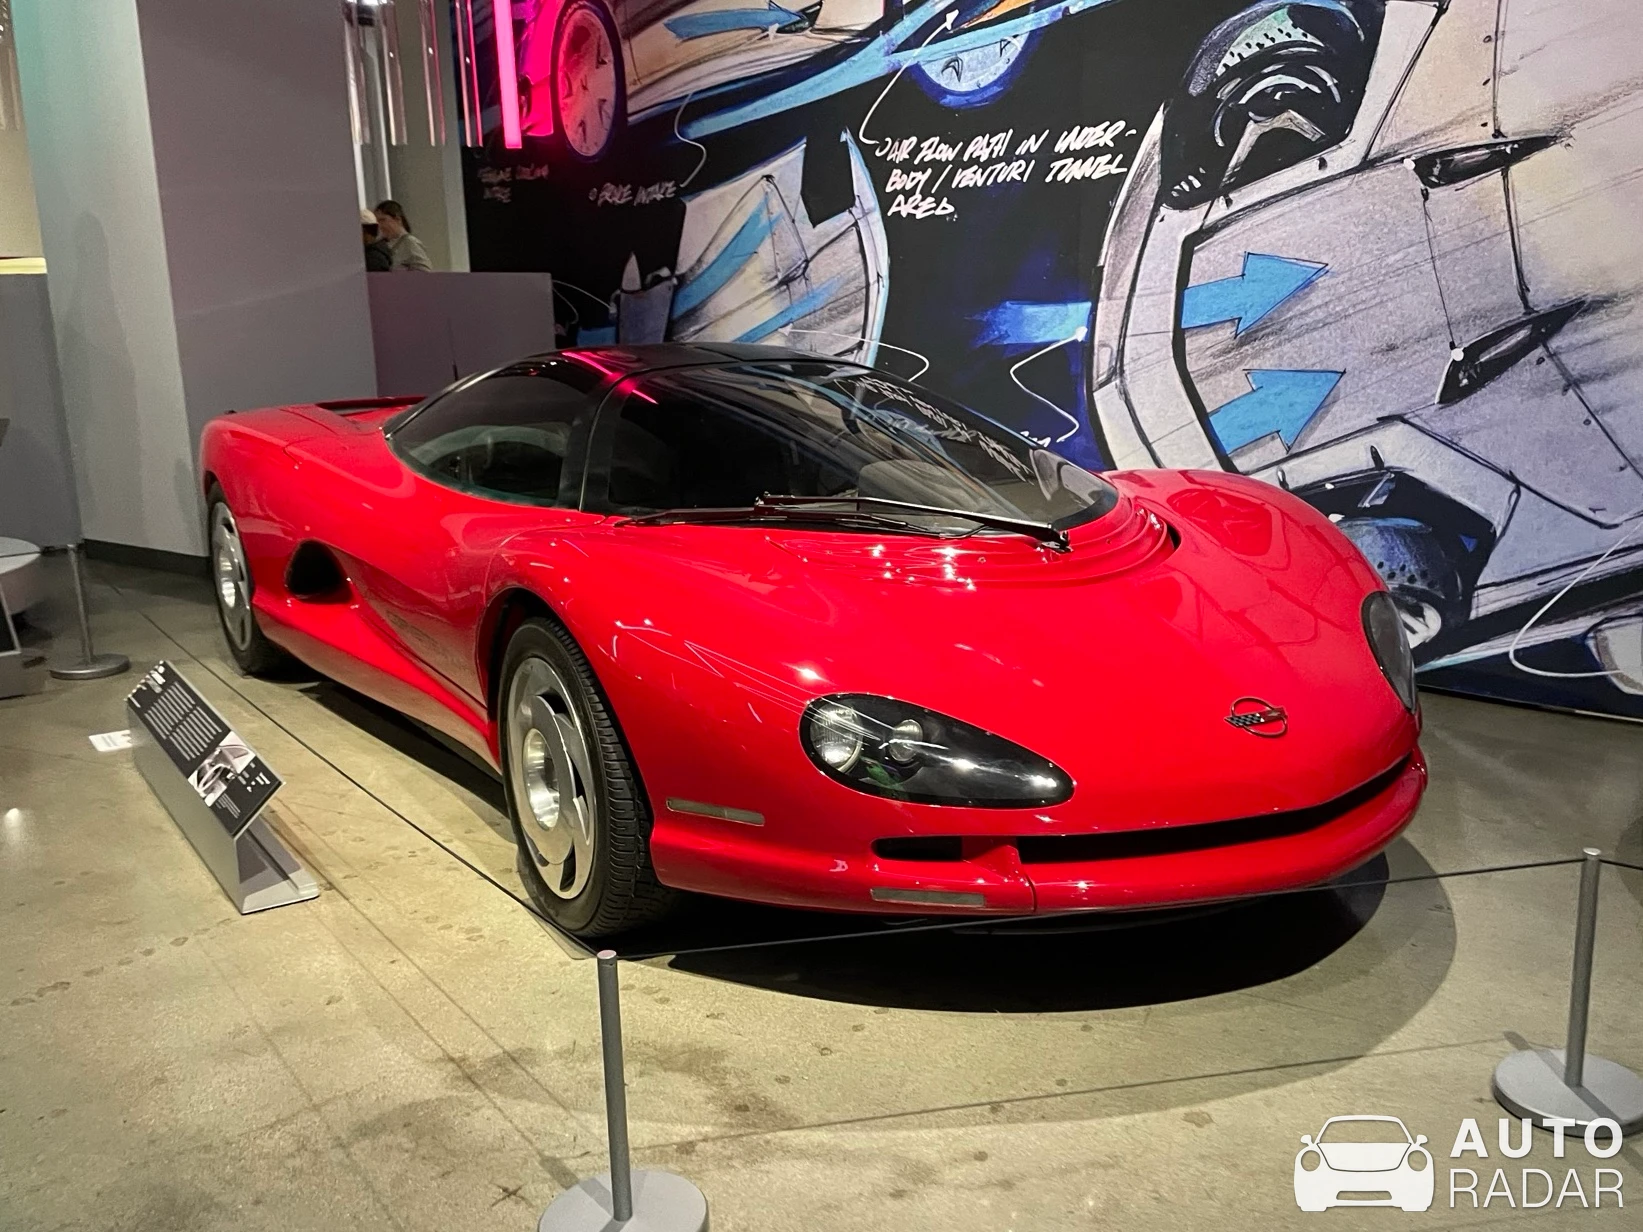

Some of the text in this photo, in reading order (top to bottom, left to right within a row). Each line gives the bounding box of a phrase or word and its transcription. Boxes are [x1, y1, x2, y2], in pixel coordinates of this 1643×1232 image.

[886, 136, 918, 164] AIR
[914, 136, 963, 165] FLOW
[963, 128, 1014, 163] PATH
[1015, 129, 1050, 155] IN
[885, 168, 933, 196] BODY
[951, 159, 1036, 189] VENTURI
